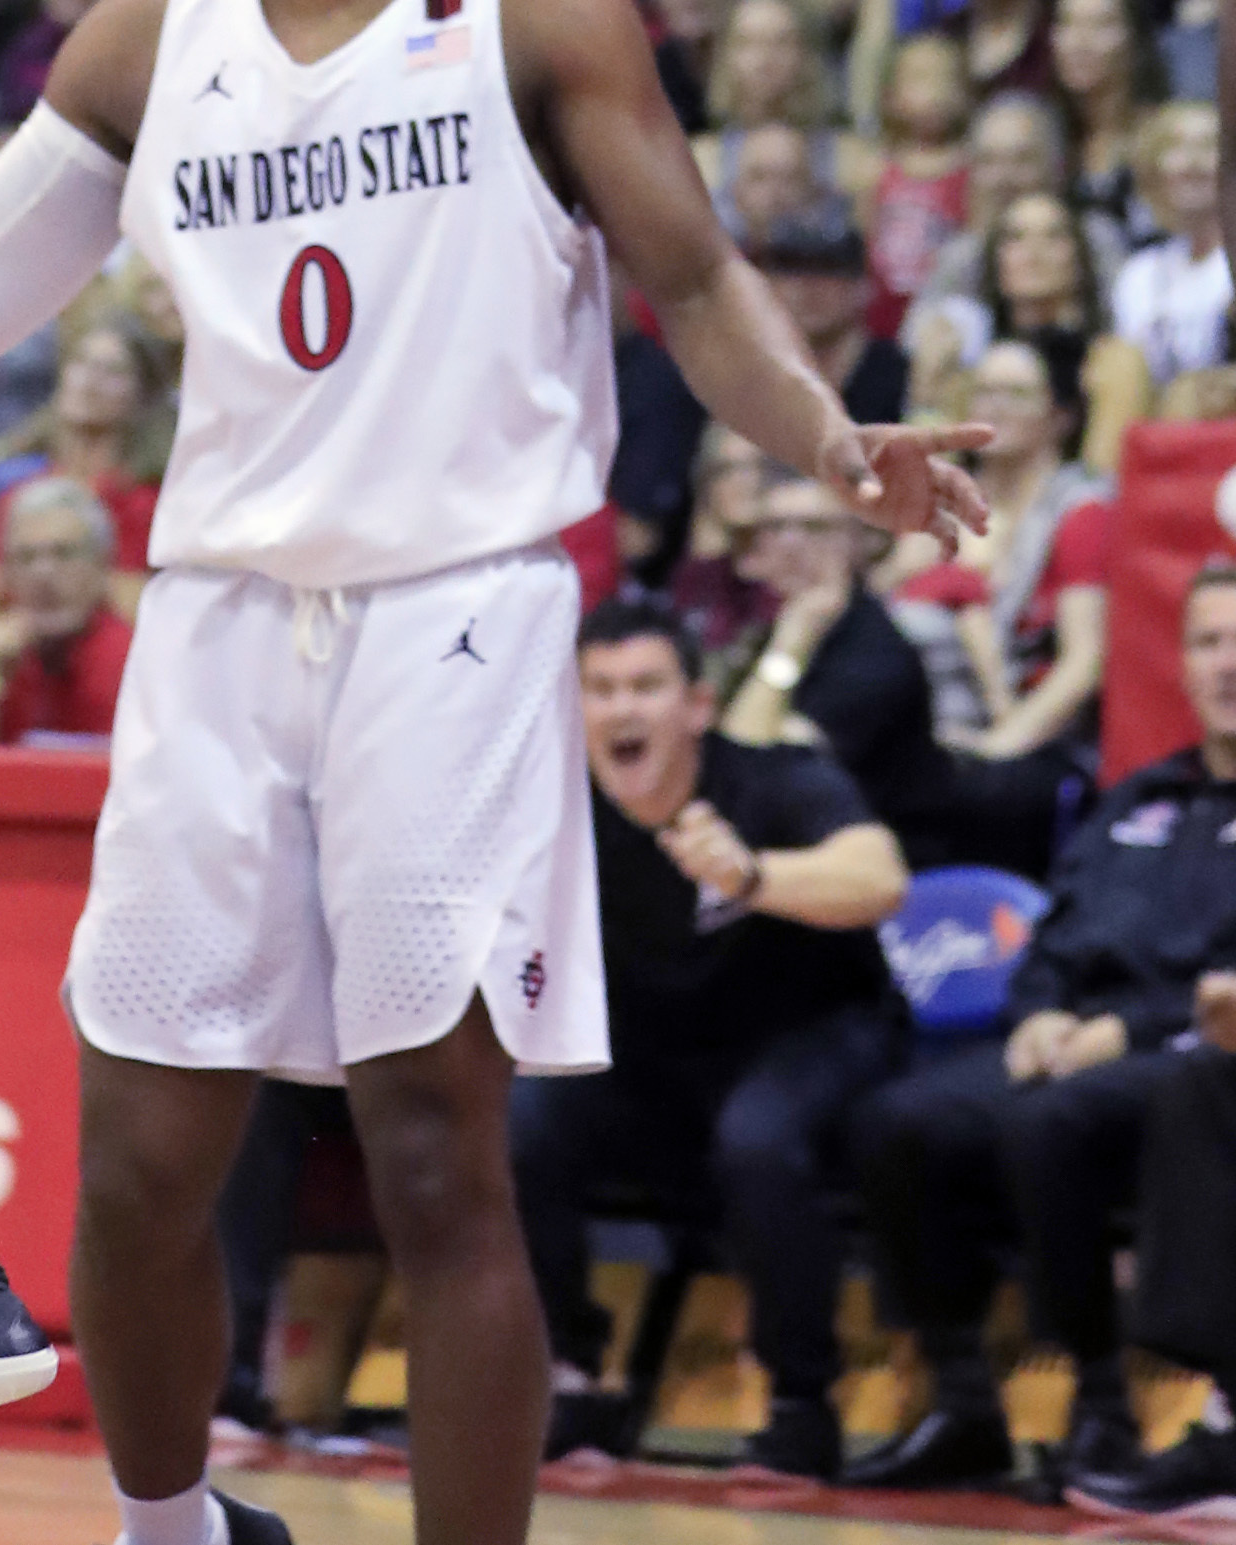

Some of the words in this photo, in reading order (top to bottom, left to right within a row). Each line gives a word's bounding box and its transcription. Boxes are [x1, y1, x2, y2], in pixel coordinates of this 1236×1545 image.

[173, 154, 238, 231] SAN
[250, 134, 347, 224] DEGO
[358, 112, 470, 198] STATE
[278, 243, 353, 372] 0
